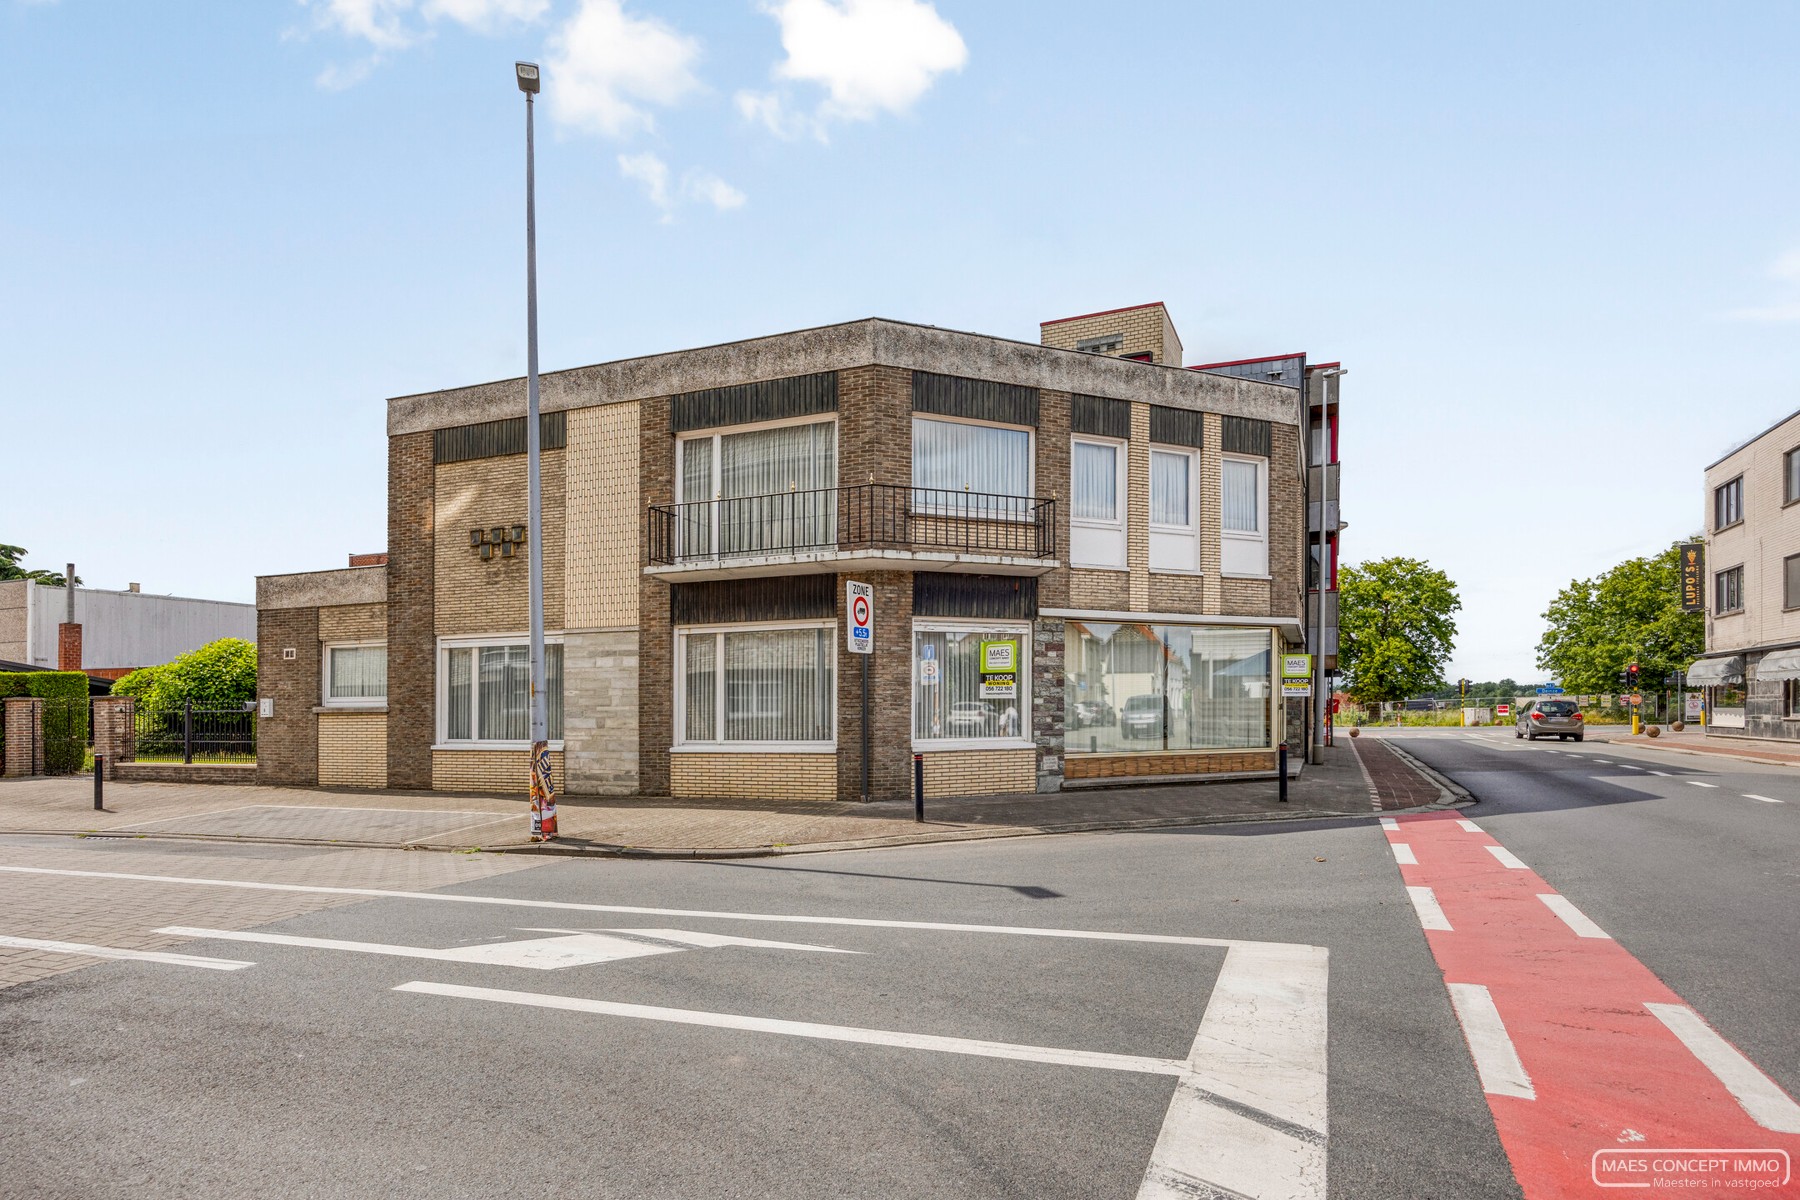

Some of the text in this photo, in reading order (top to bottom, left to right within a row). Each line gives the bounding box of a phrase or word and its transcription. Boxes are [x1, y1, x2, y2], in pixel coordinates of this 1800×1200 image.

[853, 584, 869, 596] ZONE
[1685, 566, 1696, 605] LUPO'S
[989, 649, 1010, 657] MAES
